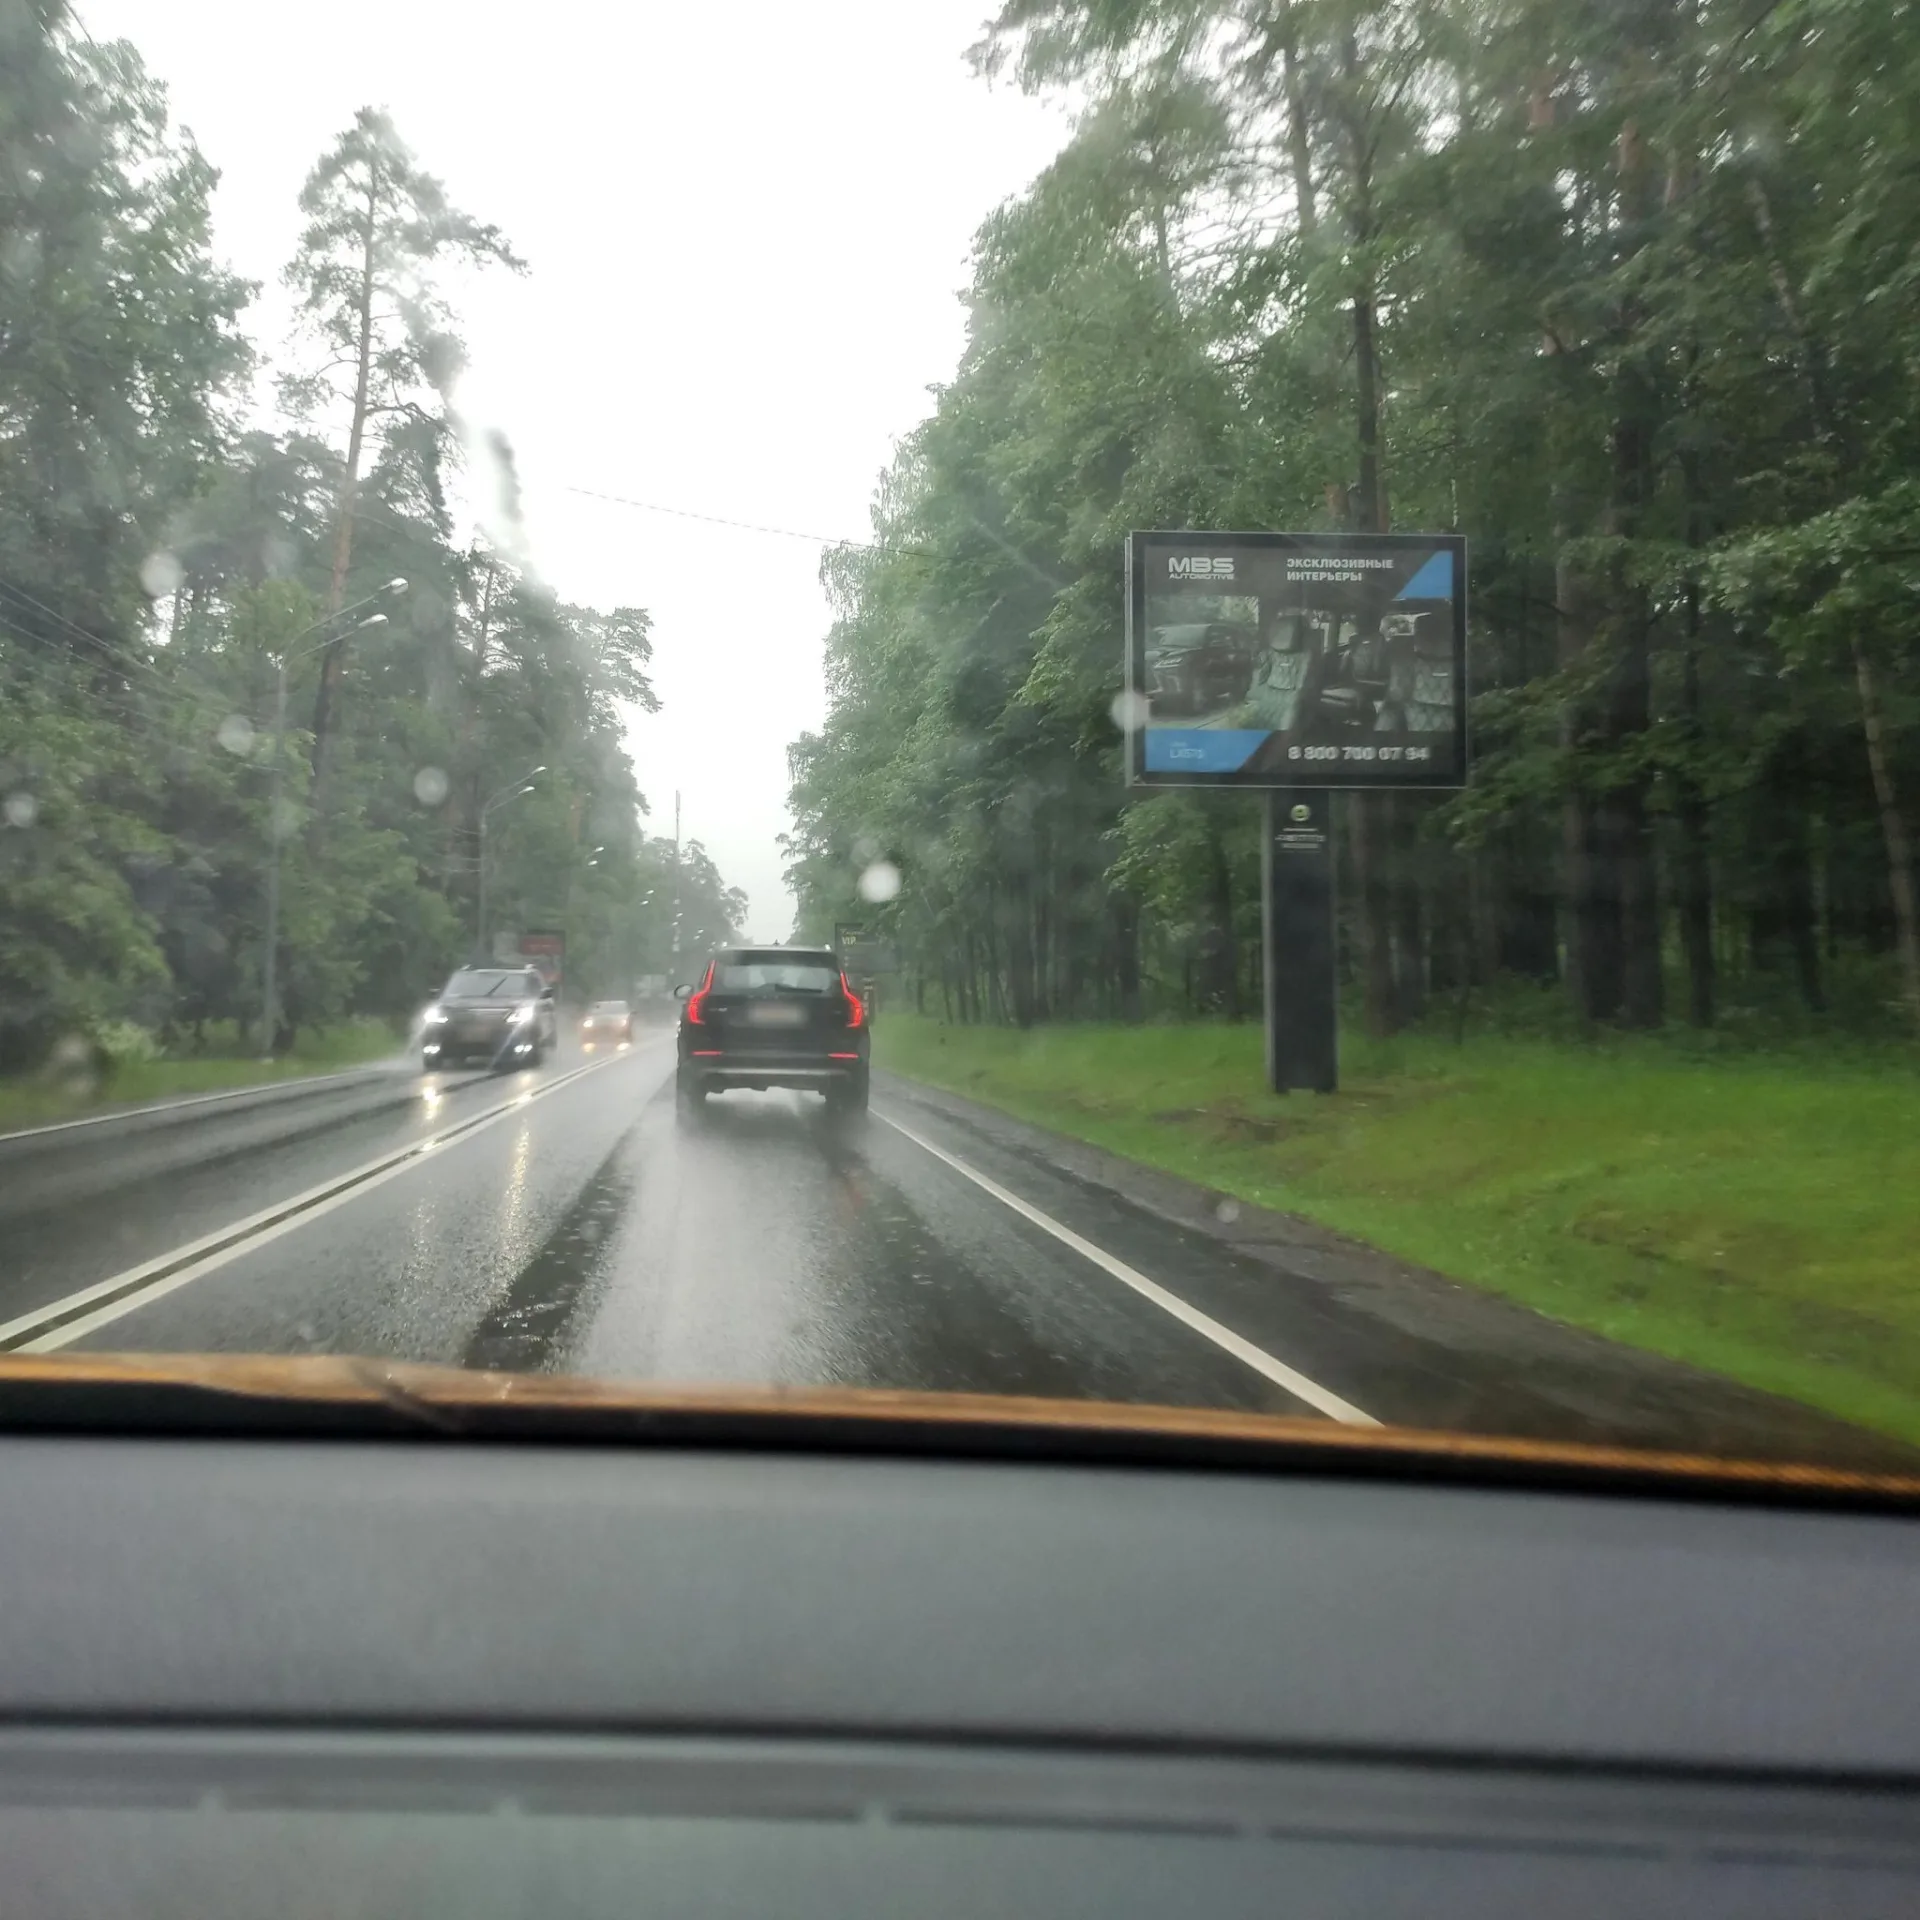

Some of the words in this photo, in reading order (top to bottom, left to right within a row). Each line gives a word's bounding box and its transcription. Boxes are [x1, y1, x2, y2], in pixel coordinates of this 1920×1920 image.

[1168, 557, 1235, 573] MBS
[1287, 558, 1394, 569] ЭКСКЛЮЗИВНЫЕ
[1287, 571, 1362, 581] ИНТЕРЬЕРЫ
[1288, 746, 1301, 760] 8
[1304, 746, 1339, 760] 800
[1341, 746, 1377, 760] 700
